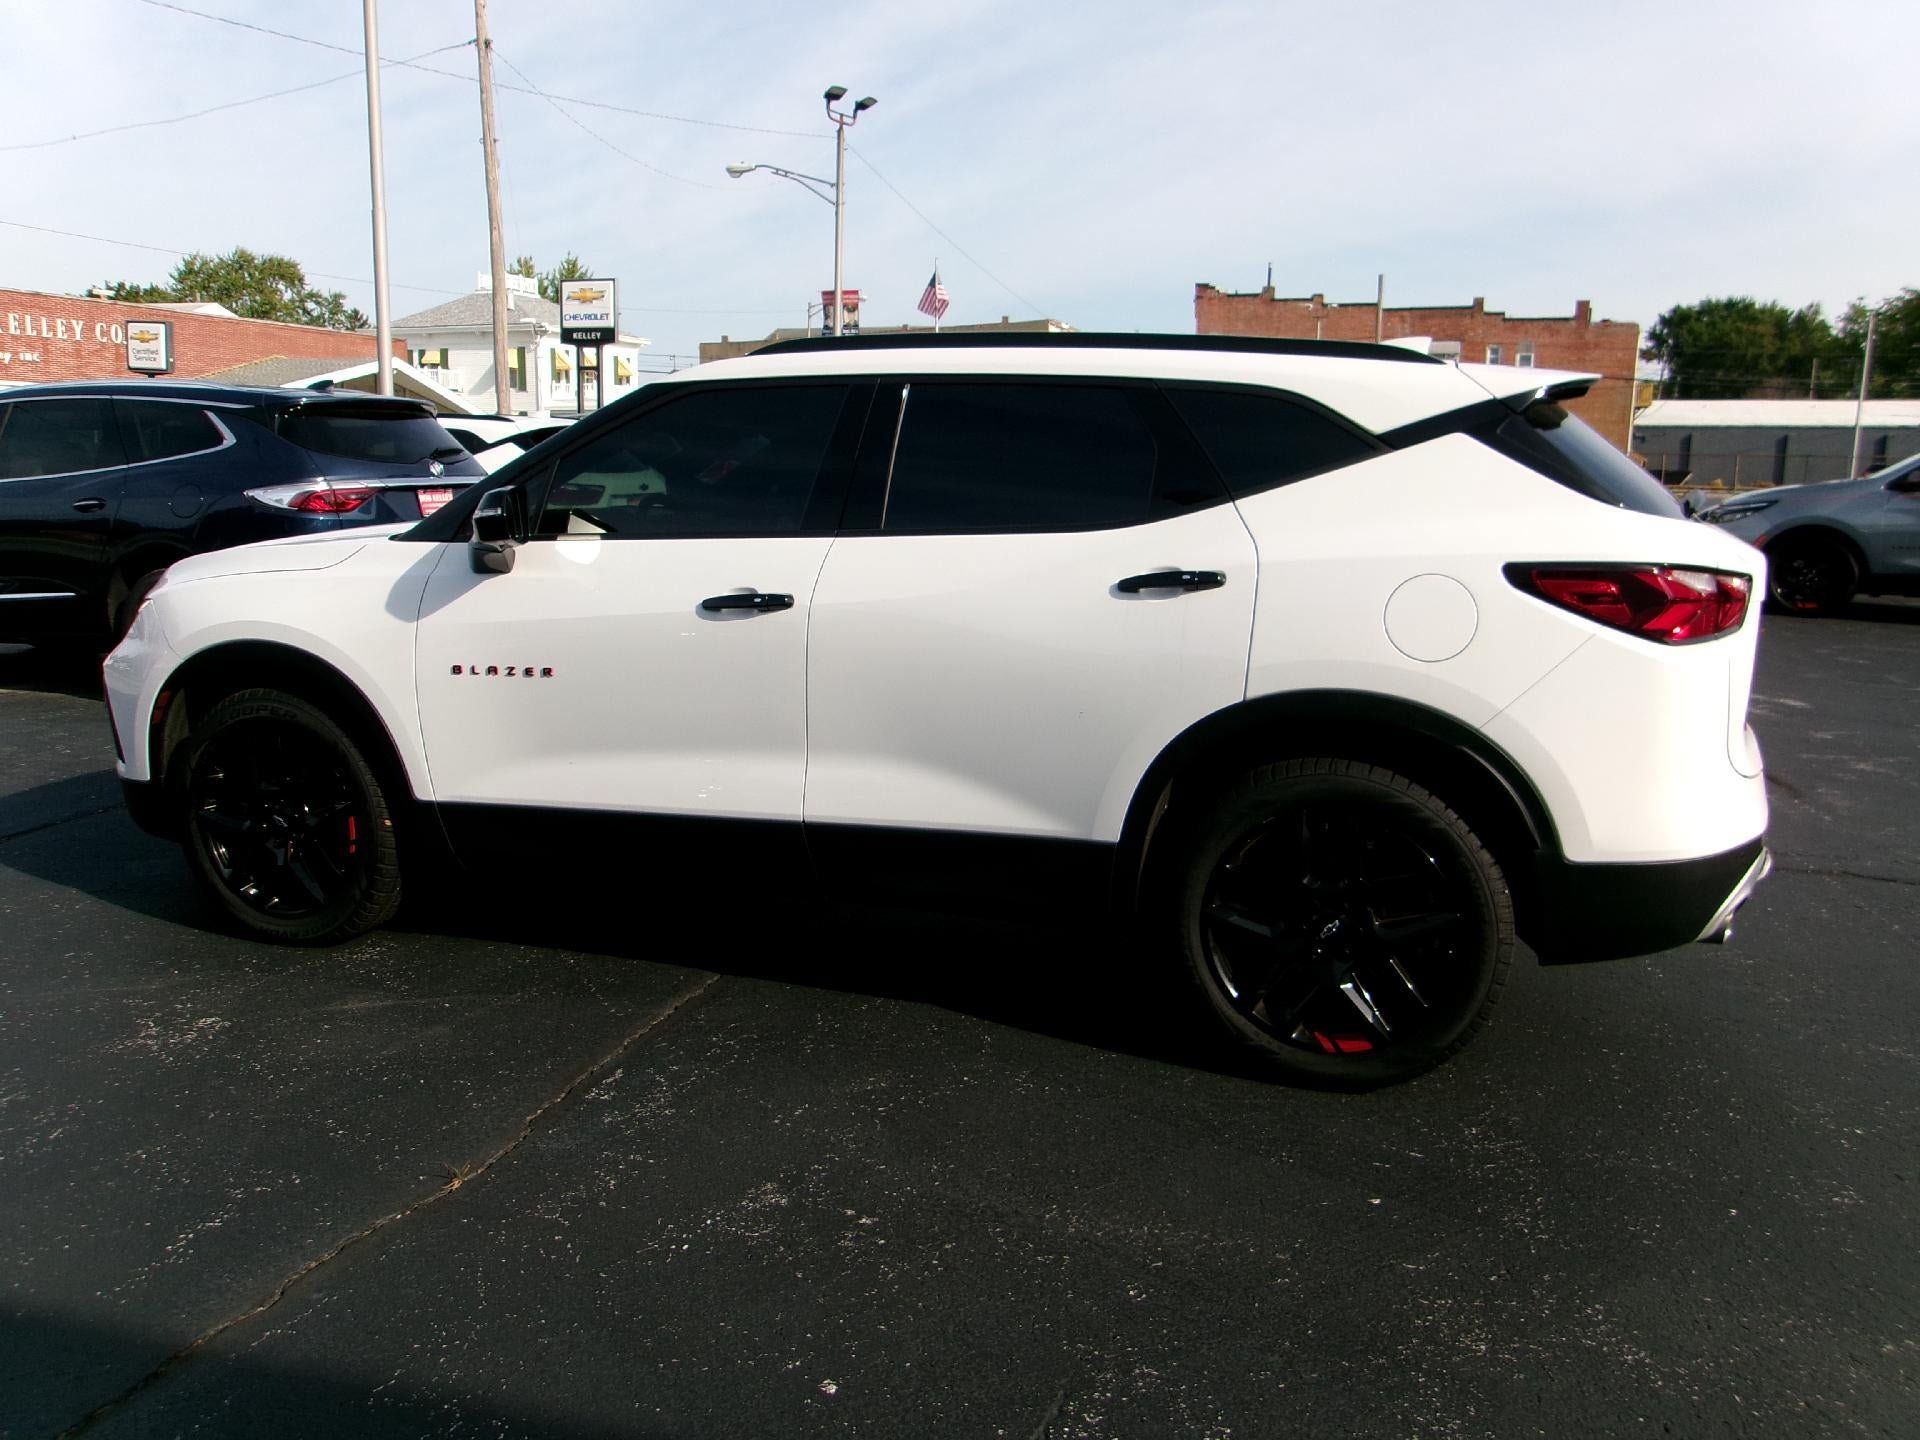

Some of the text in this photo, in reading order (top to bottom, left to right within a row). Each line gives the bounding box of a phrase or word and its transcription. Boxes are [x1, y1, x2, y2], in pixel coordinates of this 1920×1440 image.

[564, 313, 609, 321] CHEVROLET
[0, 313, 84, 341] ELLEY
[572, 332, 601, 340] KELLEY
[132, 347, 159, 355] Certified
[133, 354, 158, 362] Service
[450, 664, 553, 678] BLAZER
